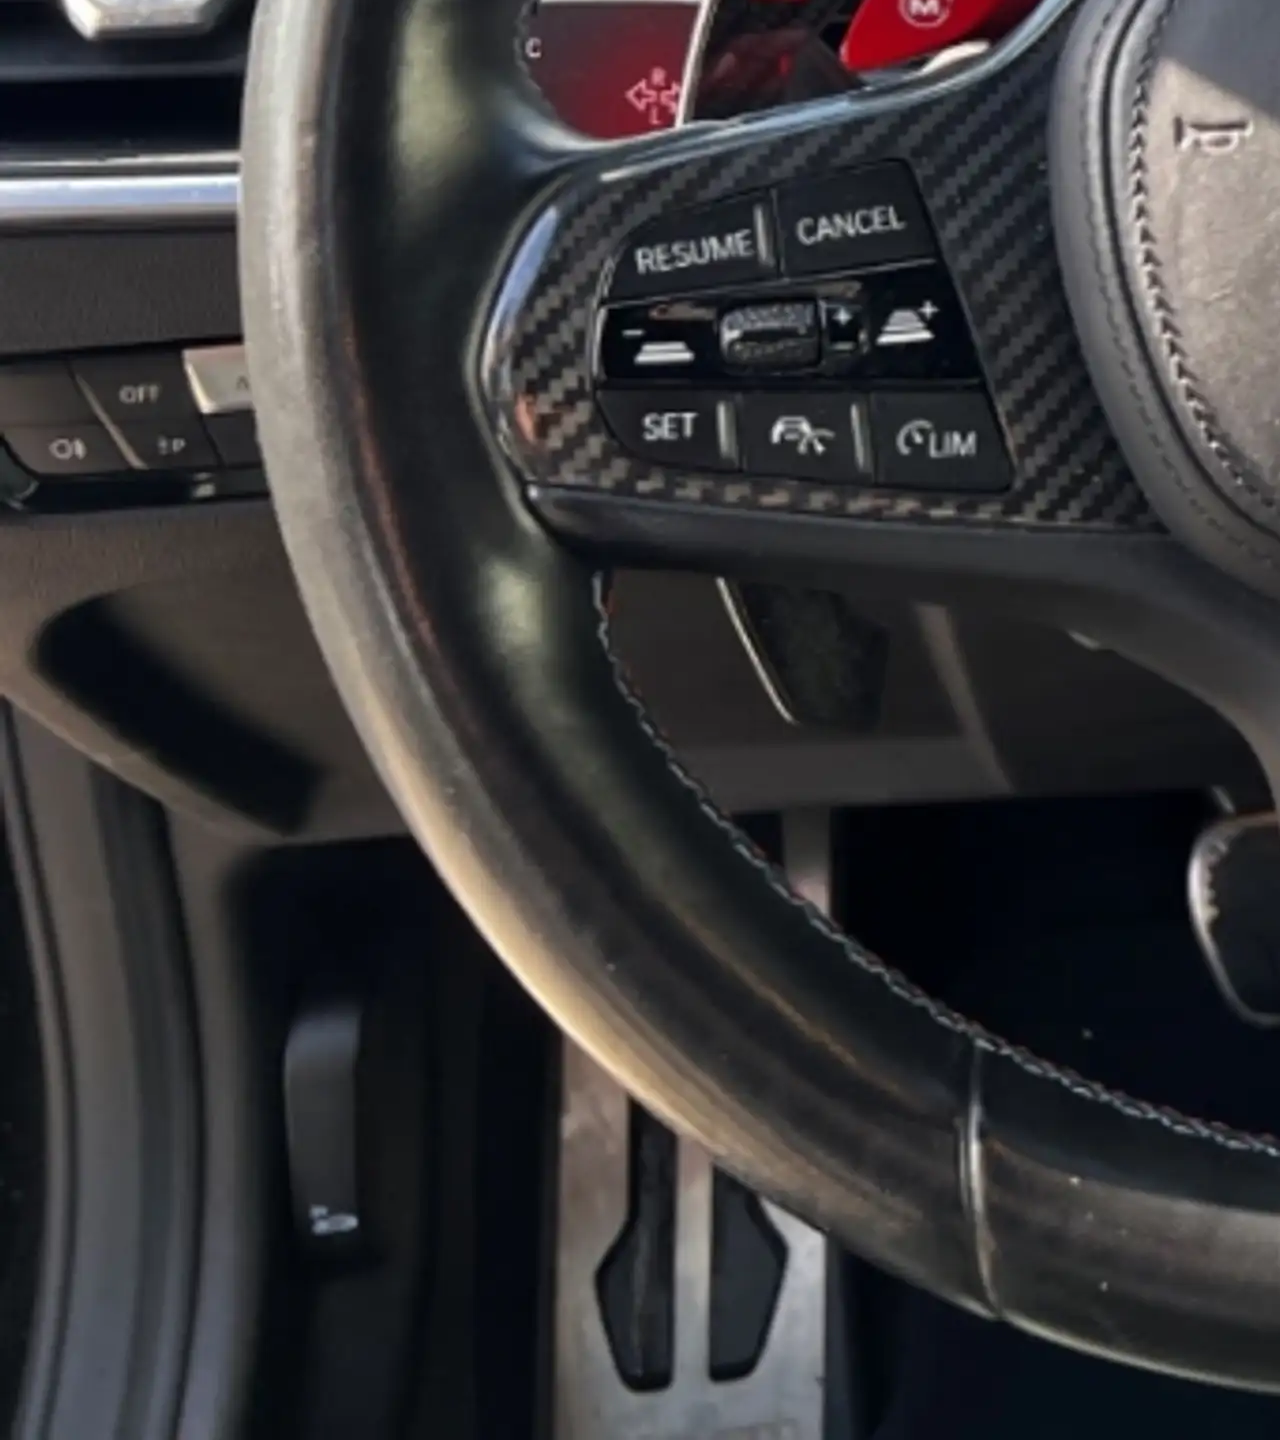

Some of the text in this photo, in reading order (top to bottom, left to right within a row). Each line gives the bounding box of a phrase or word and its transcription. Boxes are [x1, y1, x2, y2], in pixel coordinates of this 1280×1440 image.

[797, 205, 907, 245] CANCEL
[636, 229, 753, 274] RESUME
[642, 411, 699, 441] SET
[928, 432, 977, 458] LIM
